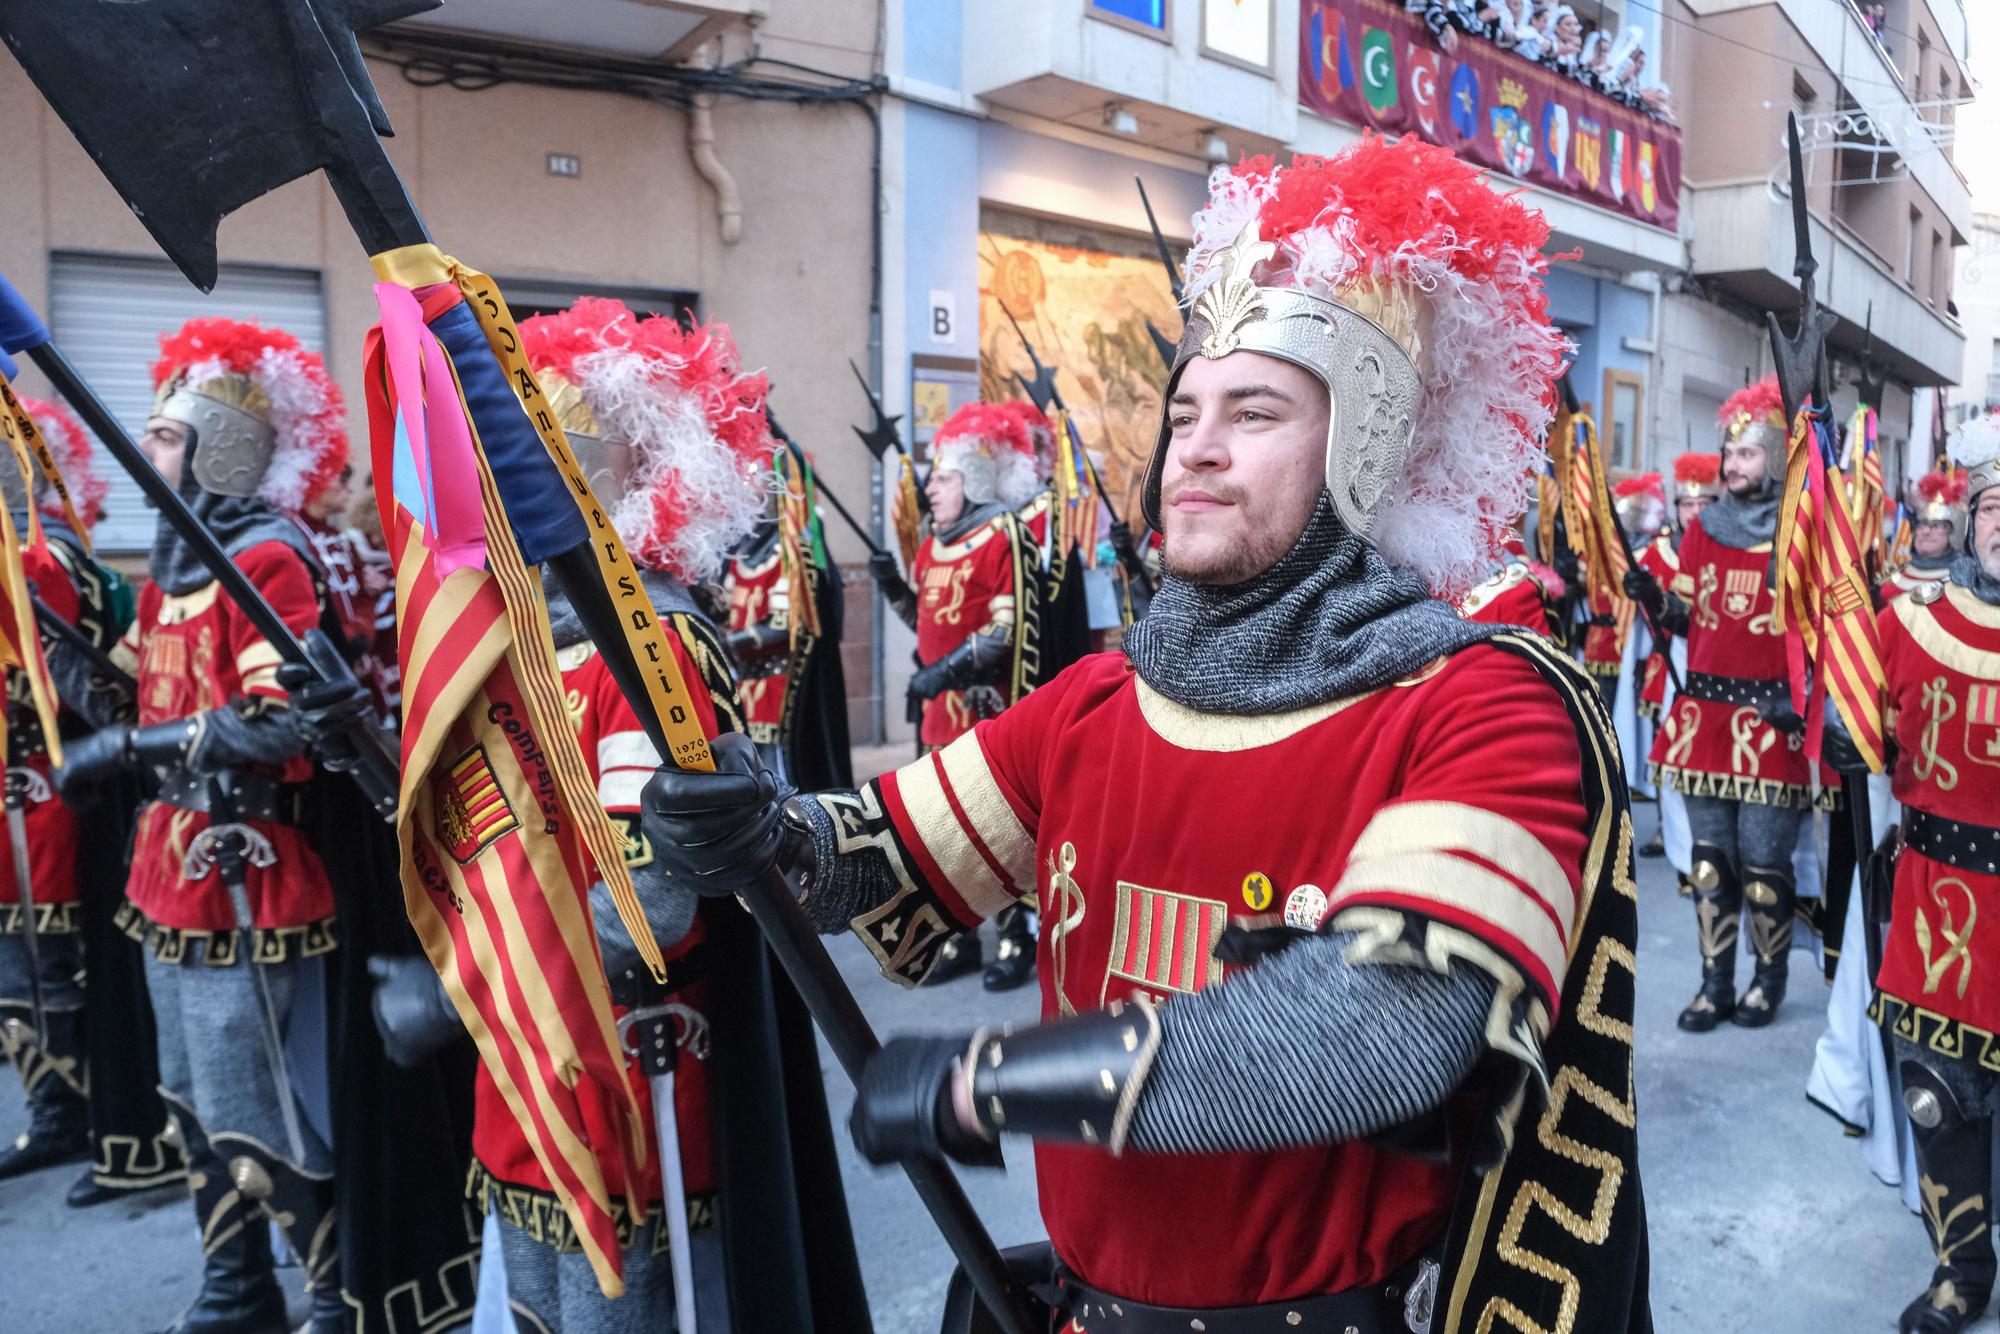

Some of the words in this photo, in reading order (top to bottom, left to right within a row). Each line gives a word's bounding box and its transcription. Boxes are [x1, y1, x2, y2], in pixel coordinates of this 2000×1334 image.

[933, 306, 951, 336] B
[514, 367, 686, 724] Aniversario
[675, 738, 704, 755] 1970
[680, 750, 709, 765] 2020
[487, 702, 560, 835] Comparsa
